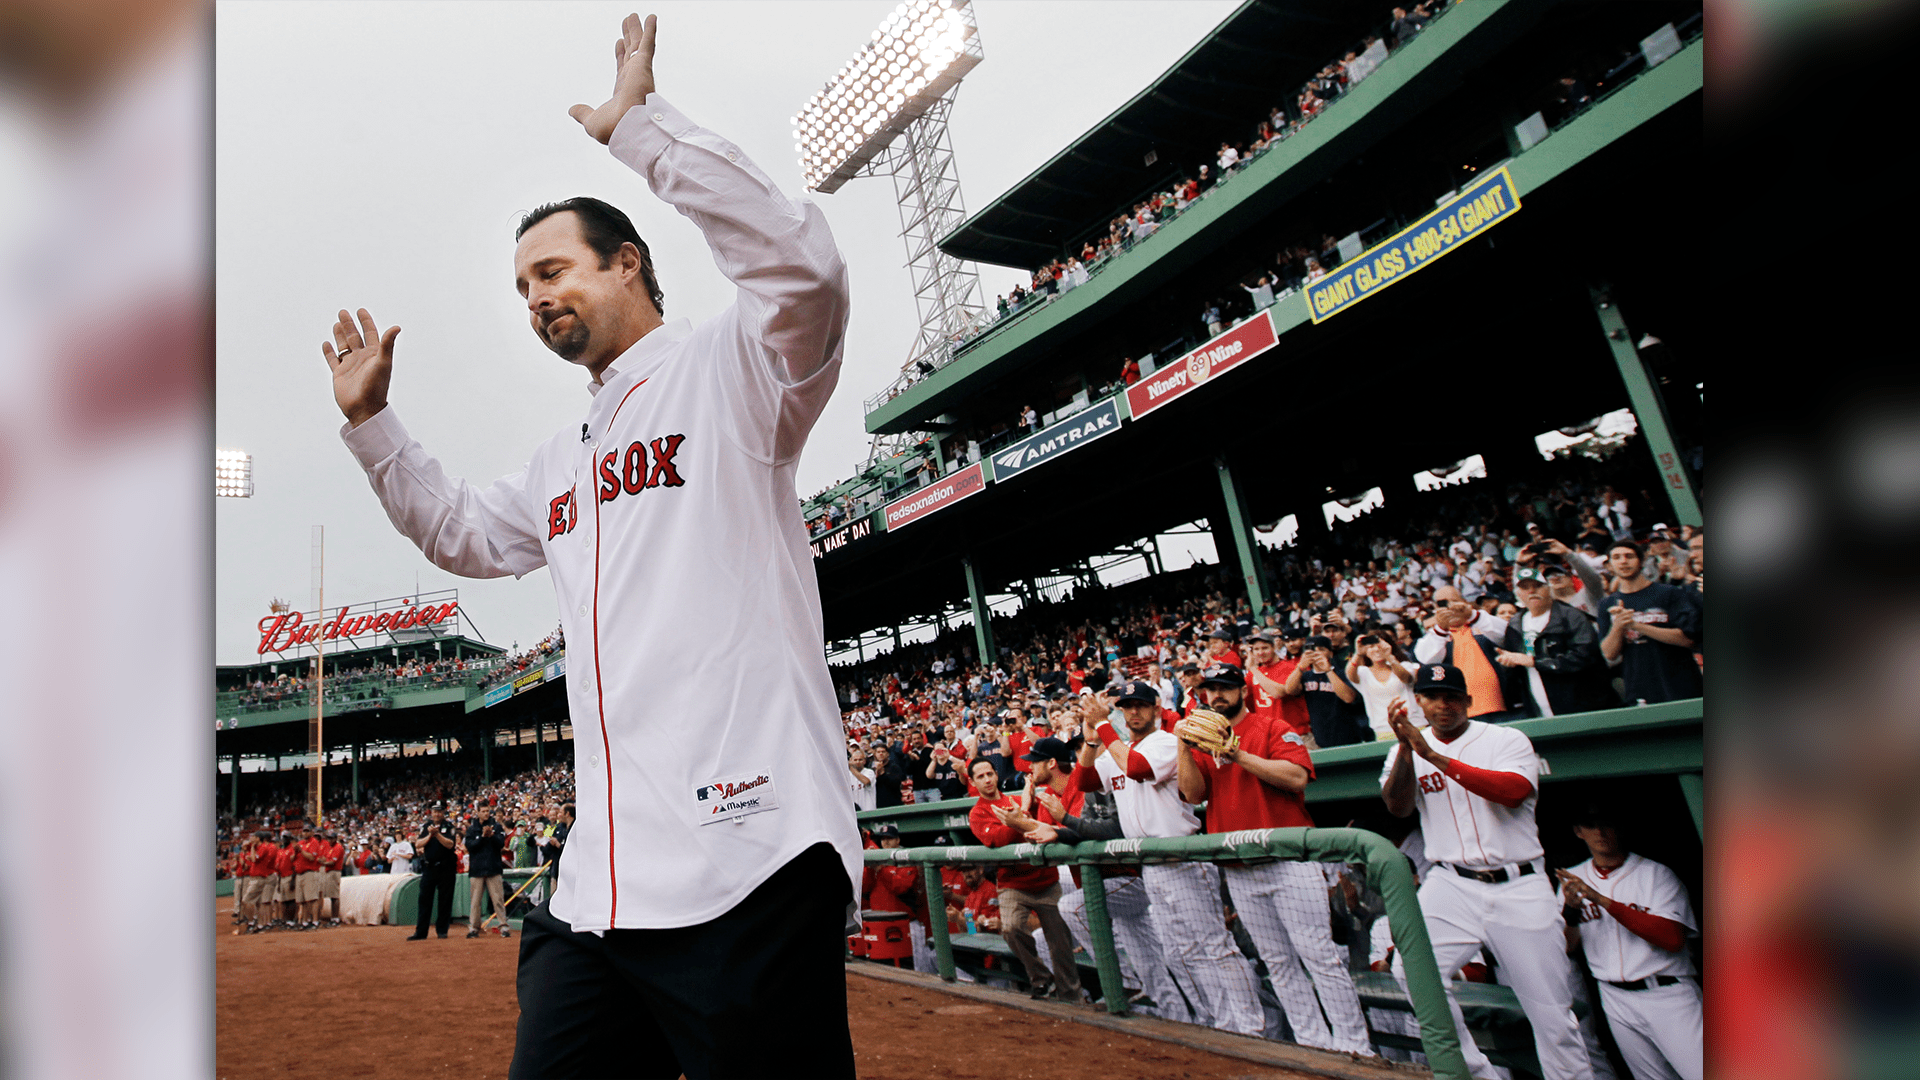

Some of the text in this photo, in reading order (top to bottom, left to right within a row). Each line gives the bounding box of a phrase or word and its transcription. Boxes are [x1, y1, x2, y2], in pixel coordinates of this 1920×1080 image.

[1313, 184, 1507, 315] GIANT GLASS 1-800-54 GIANT
[1146, 369, 1188, 400] Ninety
[1208, 340, 1243, 367] Nine
[1027, 413, 1112, 461] AMTRAK
[547, 433, 686, 541] ED SOX
[888, 473, 979, 524] redsoxnation.com
[810, 542, 823, 559] OU,
[852, 519, 871, 541] DAY
[257, 598, 459, 655] Budweiser
[721, 774, 770, 800] Authentic
[726, 798, 760, 811] Majestic
[1111, 774, 1126, 791] ED
[1418, 771, 1447, 794] ED
